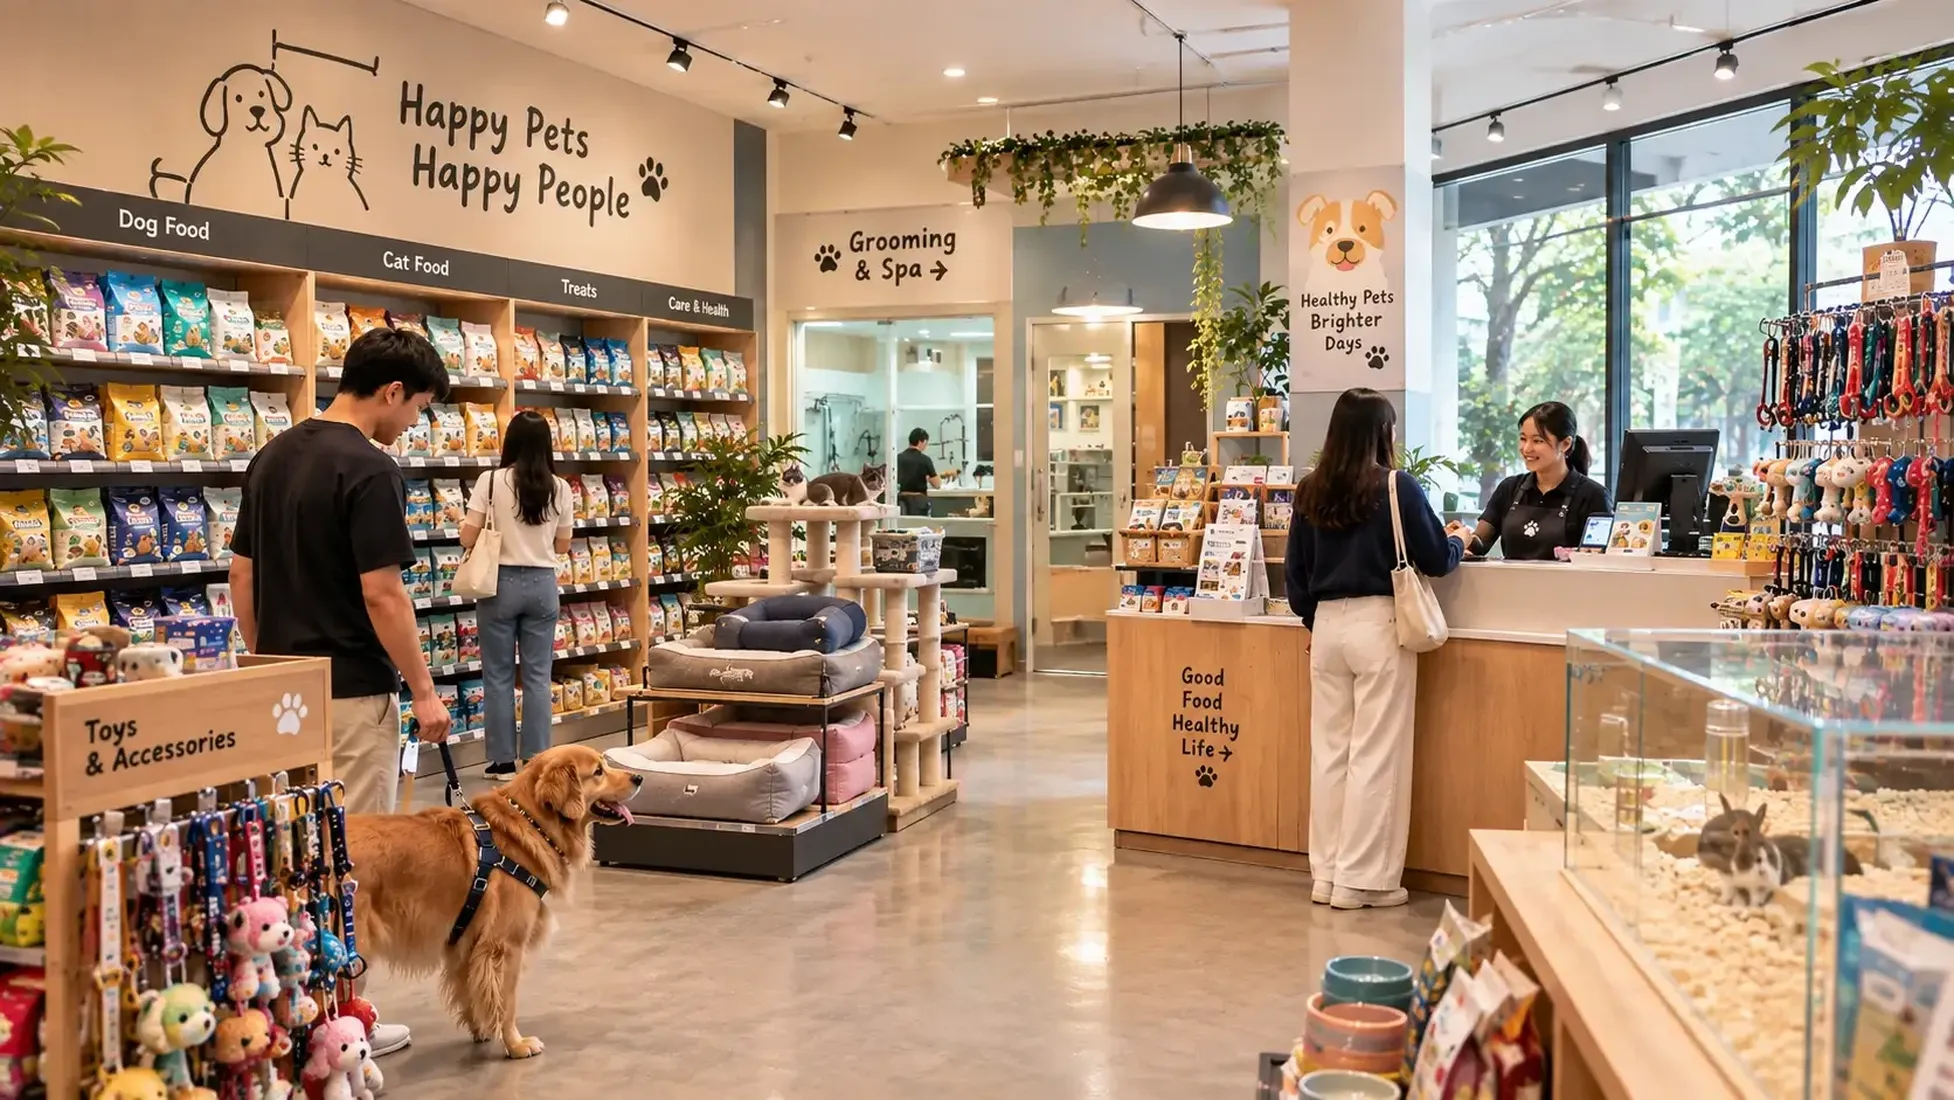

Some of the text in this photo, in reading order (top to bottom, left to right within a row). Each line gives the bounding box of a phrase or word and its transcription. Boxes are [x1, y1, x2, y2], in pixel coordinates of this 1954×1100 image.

[400, 81, 589, 158] Happy Pets
[413, 143, 630, 227] Happy People
[118, 208, 210, 241] Dog Food
[849, 227, 956, 255] Grooming
[383, 251, 449, 277] Cat Food
[855, 257, 922, 287] & Spa
[561, 278, 597, 298] Treats
[1301, 289, 1394, 310] Healthy Pets
[668, 296, 730, 317] Care & Health
[1311, 312, 1383, 333] Brighter
[1325, 336, 1362, 355] Days
[1181, 667, 1224, 686] Good
[1183, 691, 1222, 710] Food
[85, 719, 137, 746] Toys
[1173, 714, 1239, 742] Healthy
[85, 729, 236, 777] & Accessories
[1182, 738, 1214, 757] Life
